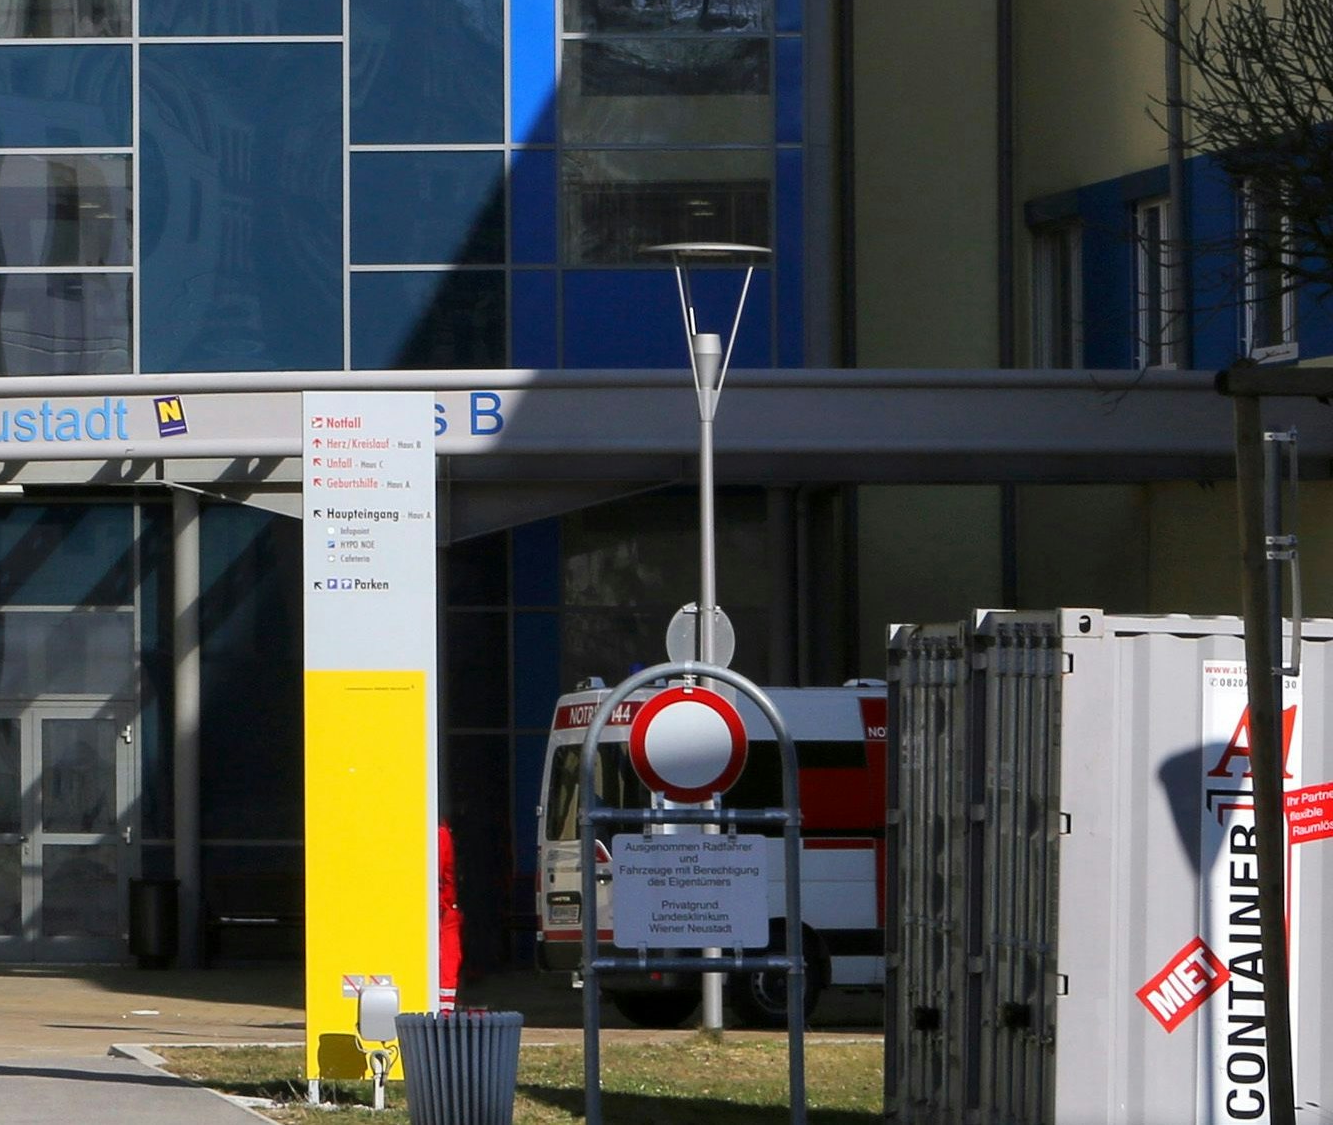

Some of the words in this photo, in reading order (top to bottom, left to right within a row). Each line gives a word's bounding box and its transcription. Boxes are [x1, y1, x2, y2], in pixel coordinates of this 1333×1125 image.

[470, 392, 505, 436] B
[326, 416, 362, 429] Notfall
[326, 437, 390, 450] Herz/Kreislauf
[326, 458, 353, 469] Unfall
[326, 477, 379, 489] Geburtshilfe
[326, 508, 400, 522] Haupteingang
[354, 578, 389, 590] Parken
[1286, 796, 1300, 807] Ihr
[1289, 806, 1324, 822] flexible
[624, 842, 700, 853] Ausgenommen
[702, 842, 752, 851] Radfahrer
[679, 854, 699, 863] und
[619, 865, 673, 876] Fahrzeuge
[675, 865, 691, 874] mit
[693, 865, 759, 876] Berechtigung
[647, 877, 666, 886] des
[661, 900, 719, 911] Privatgrund
[651, 912, 729, 922] Landesklinikum
[648, 924, 685, 933] Wiener
[687, 924, 733, 933] Neustadt
[1146, 947, 1218, 1022] MIET
